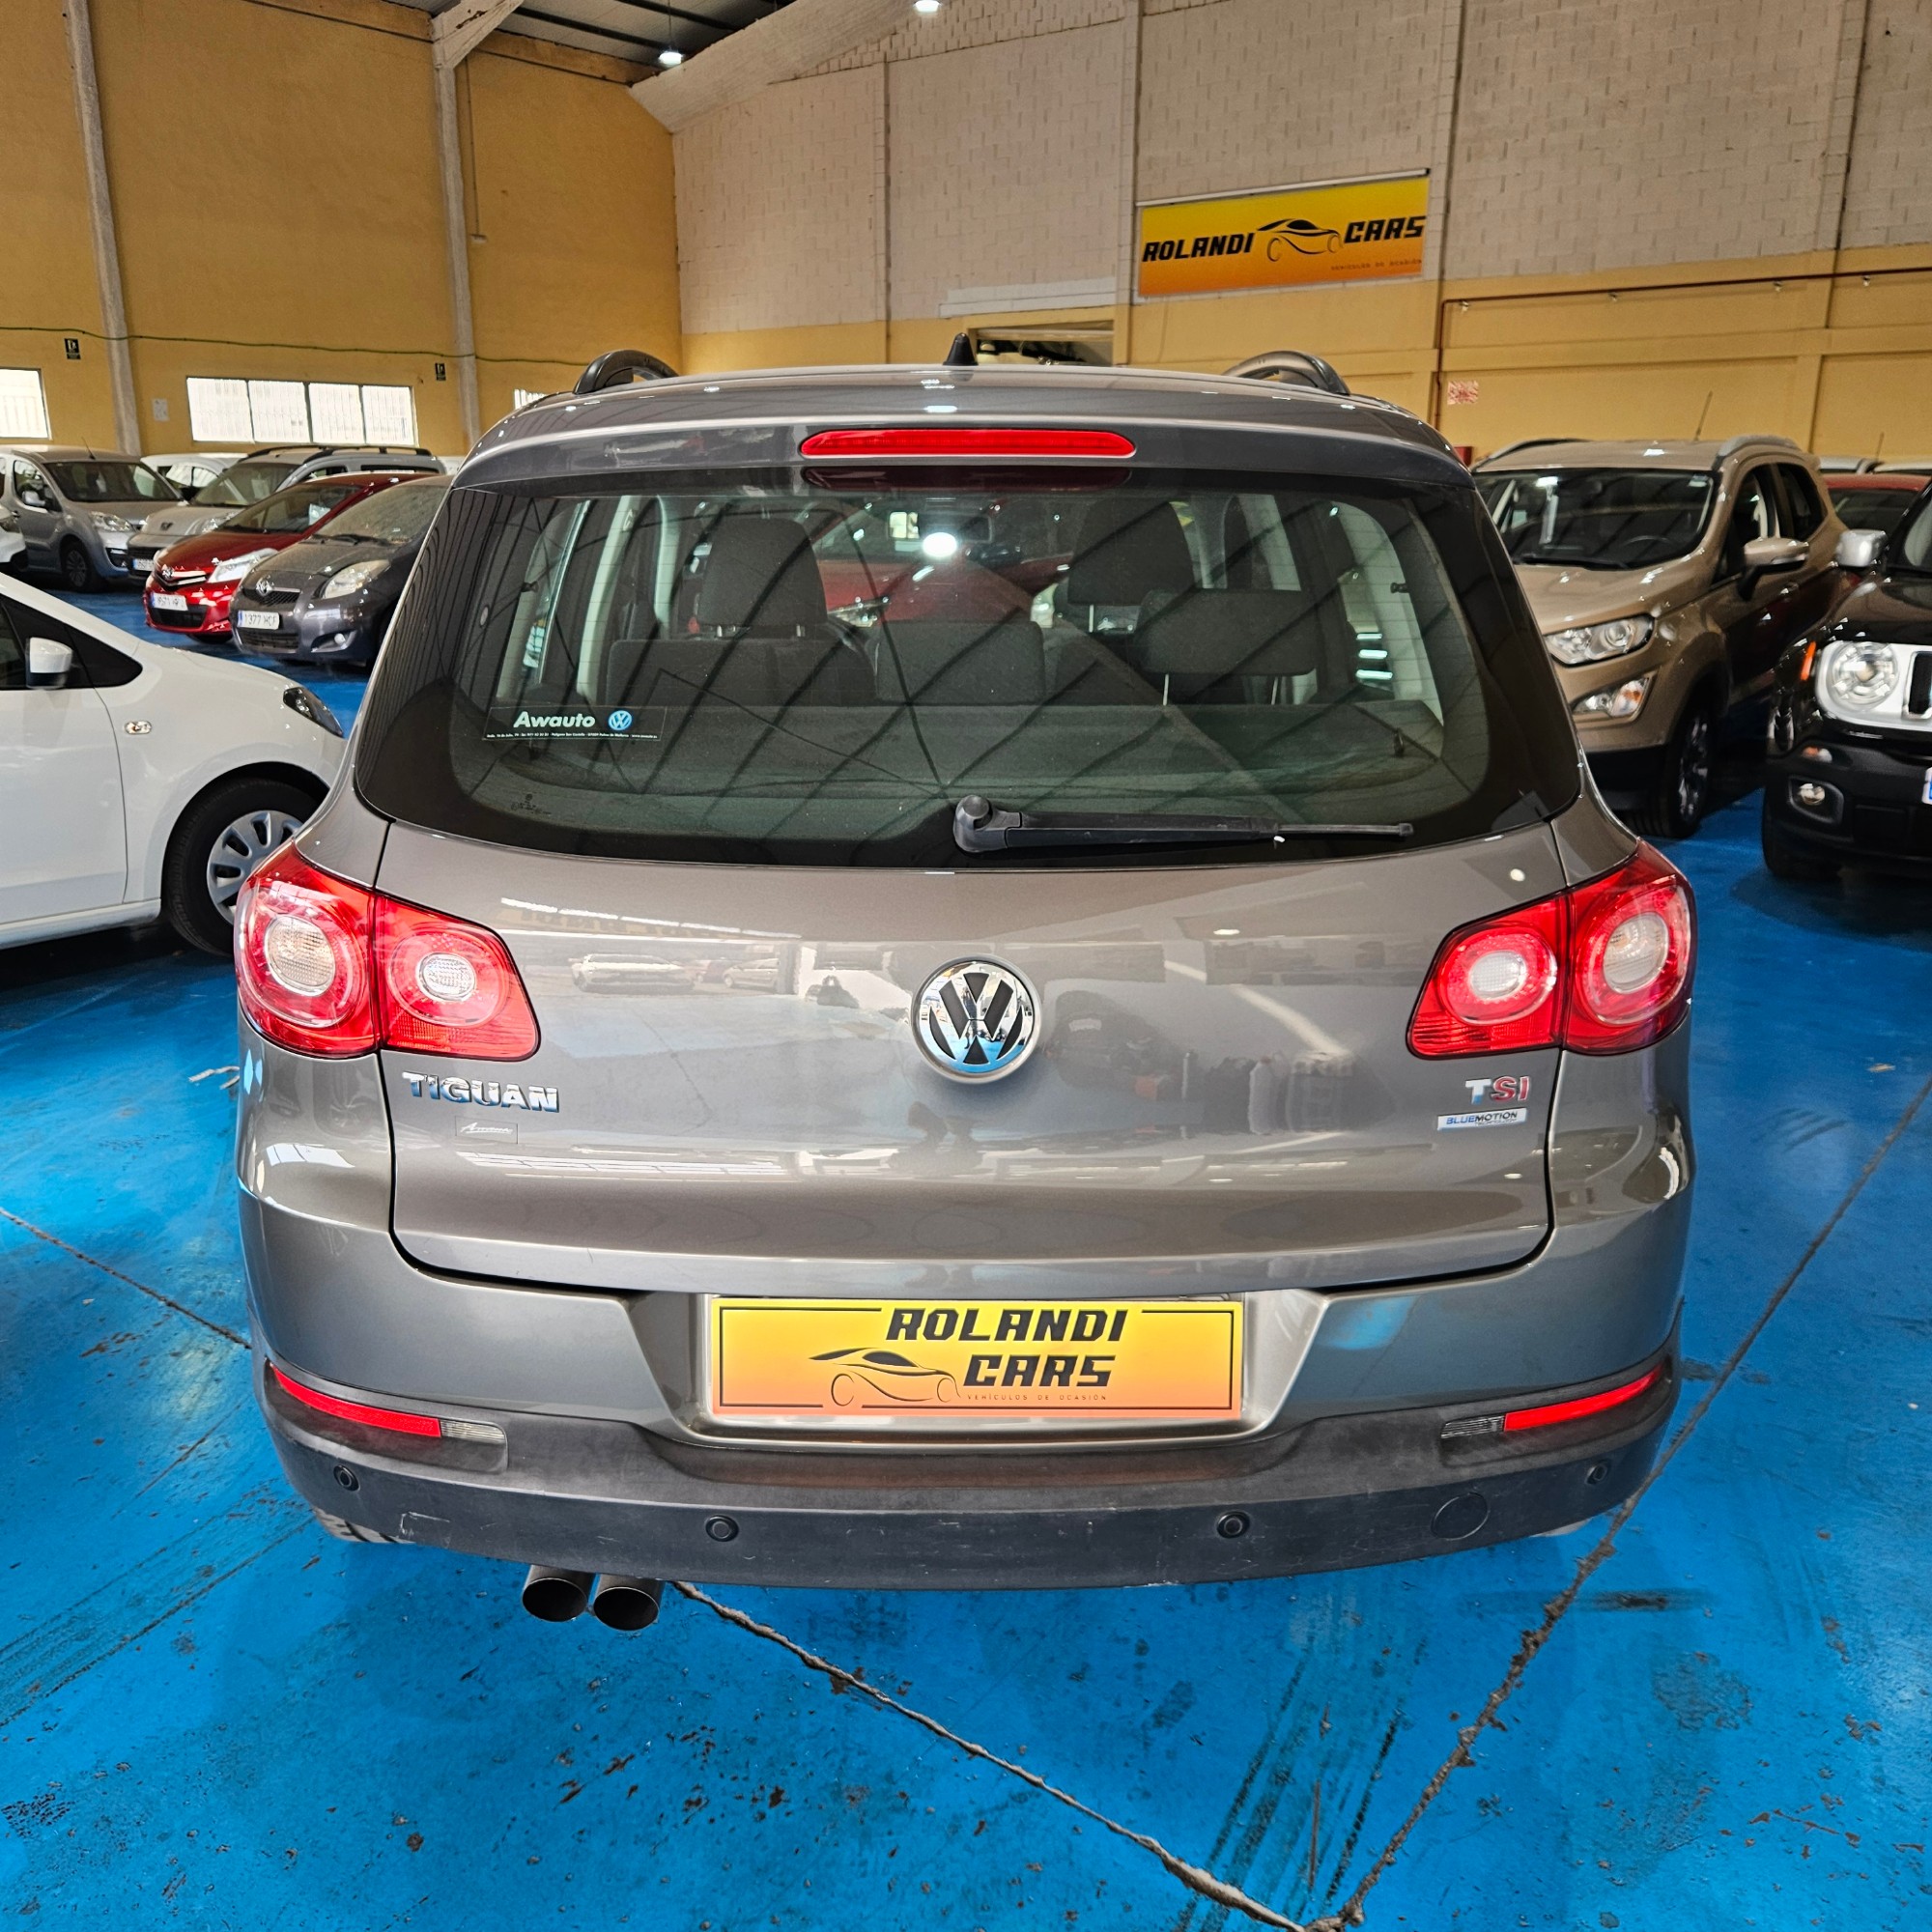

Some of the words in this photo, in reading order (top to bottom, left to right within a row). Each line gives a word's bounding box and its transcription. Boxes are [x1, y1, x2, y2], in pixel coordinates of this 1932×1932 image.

[1142, 232, 1256, 262] ROLANDI
[1344, 215, 1427, 243] CARS
[513, 711, 596, 728] Awauto
[402, 1071, 560, 1113] TIGUAN
[1464, 1075, 1530, 1105] TSI
[1445, 1111, 1519, 1125] BLUEMOTION
[886, 1308, 1129, 1342] ROLANDI
[963, 1354, 1117, 1387] CARS
